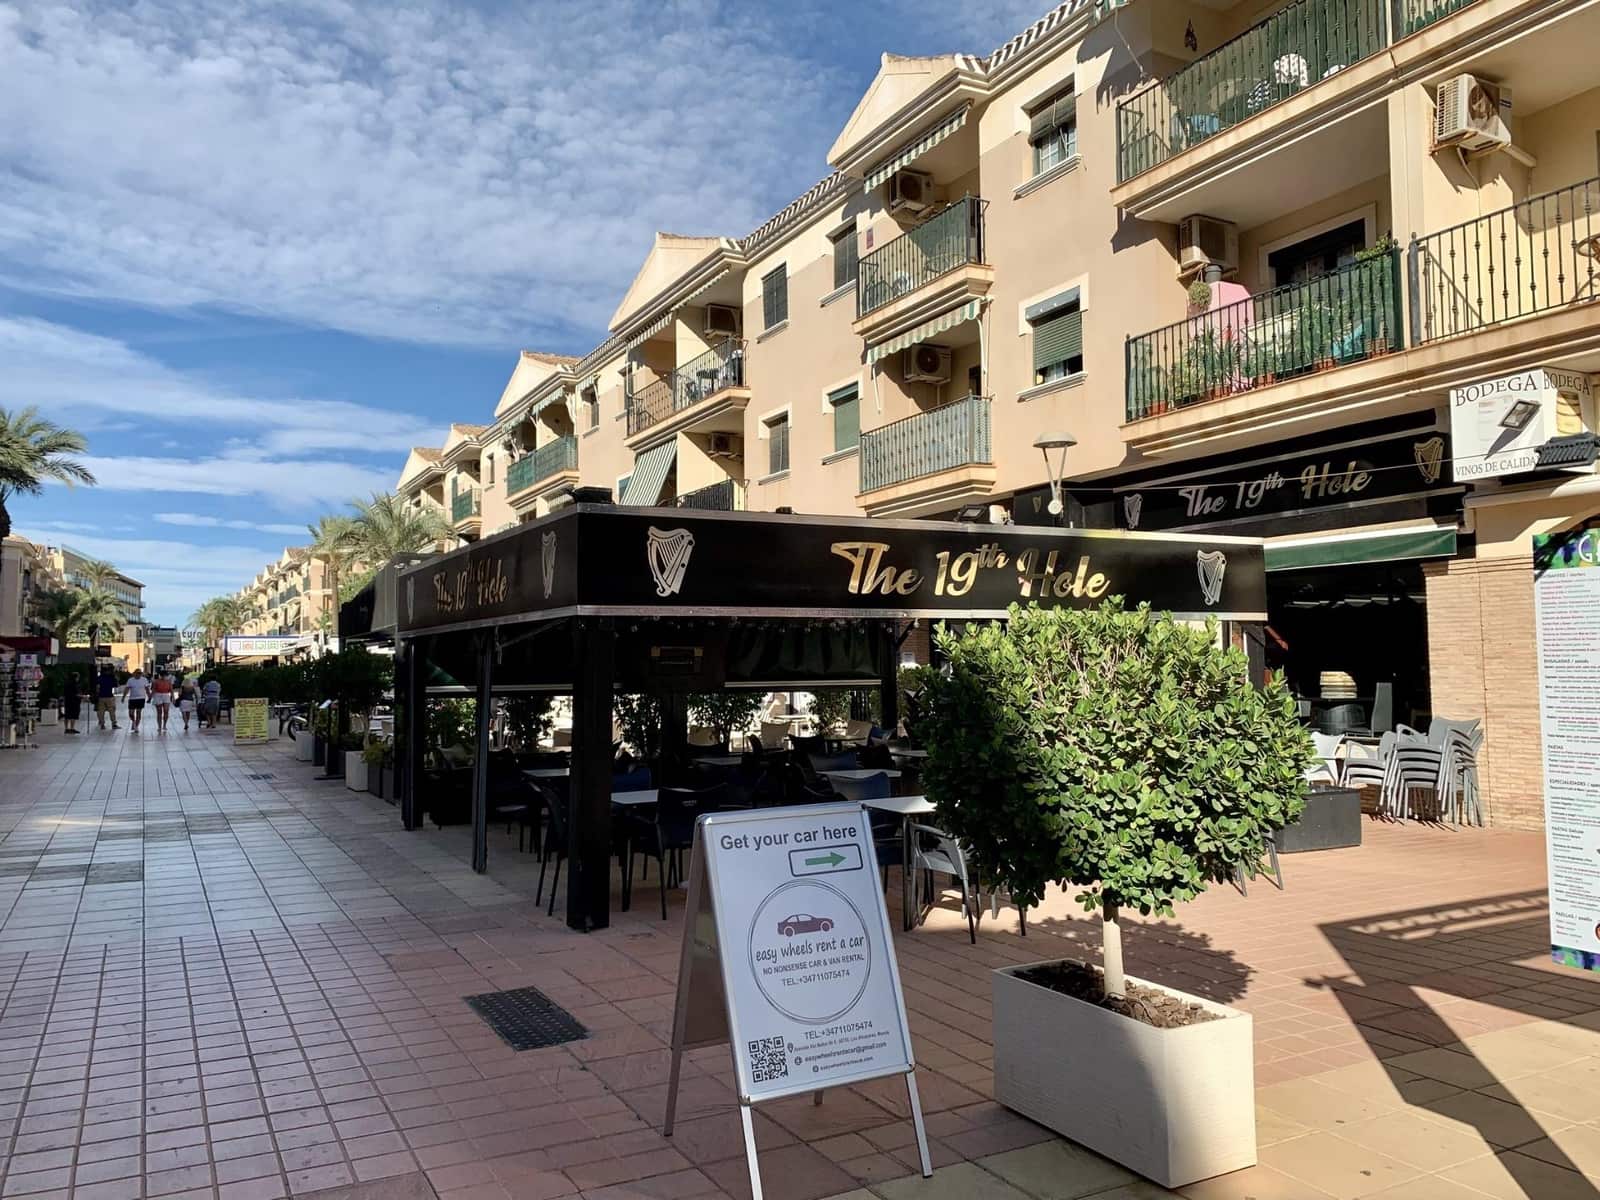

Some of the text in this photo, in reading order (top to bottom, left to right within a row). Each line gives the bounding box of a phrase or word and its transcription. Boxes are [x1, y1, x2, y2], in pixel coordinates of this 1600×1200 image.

[1455, 374, 1537, 406] BODEGA
[1544, 372, 1591, 395] BODEGA
[1455, 456, 1540, 477] VINOS DE CALIDA
[1178, 486, 1226, 517] The
[1300, 461, 1373, 499] Hole
[830, 542, 924, 595] The
[1016, 547, 1111, 599] Hole
[720, 825, 857, 851] Get your car here
[756, 936, 864, 964] easy wheels rent a car
[763, 966, 773, 975] NO
[774, 961, 807, 974] NONSENSE
[809, 959, 823, 968] CAR
[829, 957, 841, 965] VAN
[842, 953, 864, 963] RENTAL
